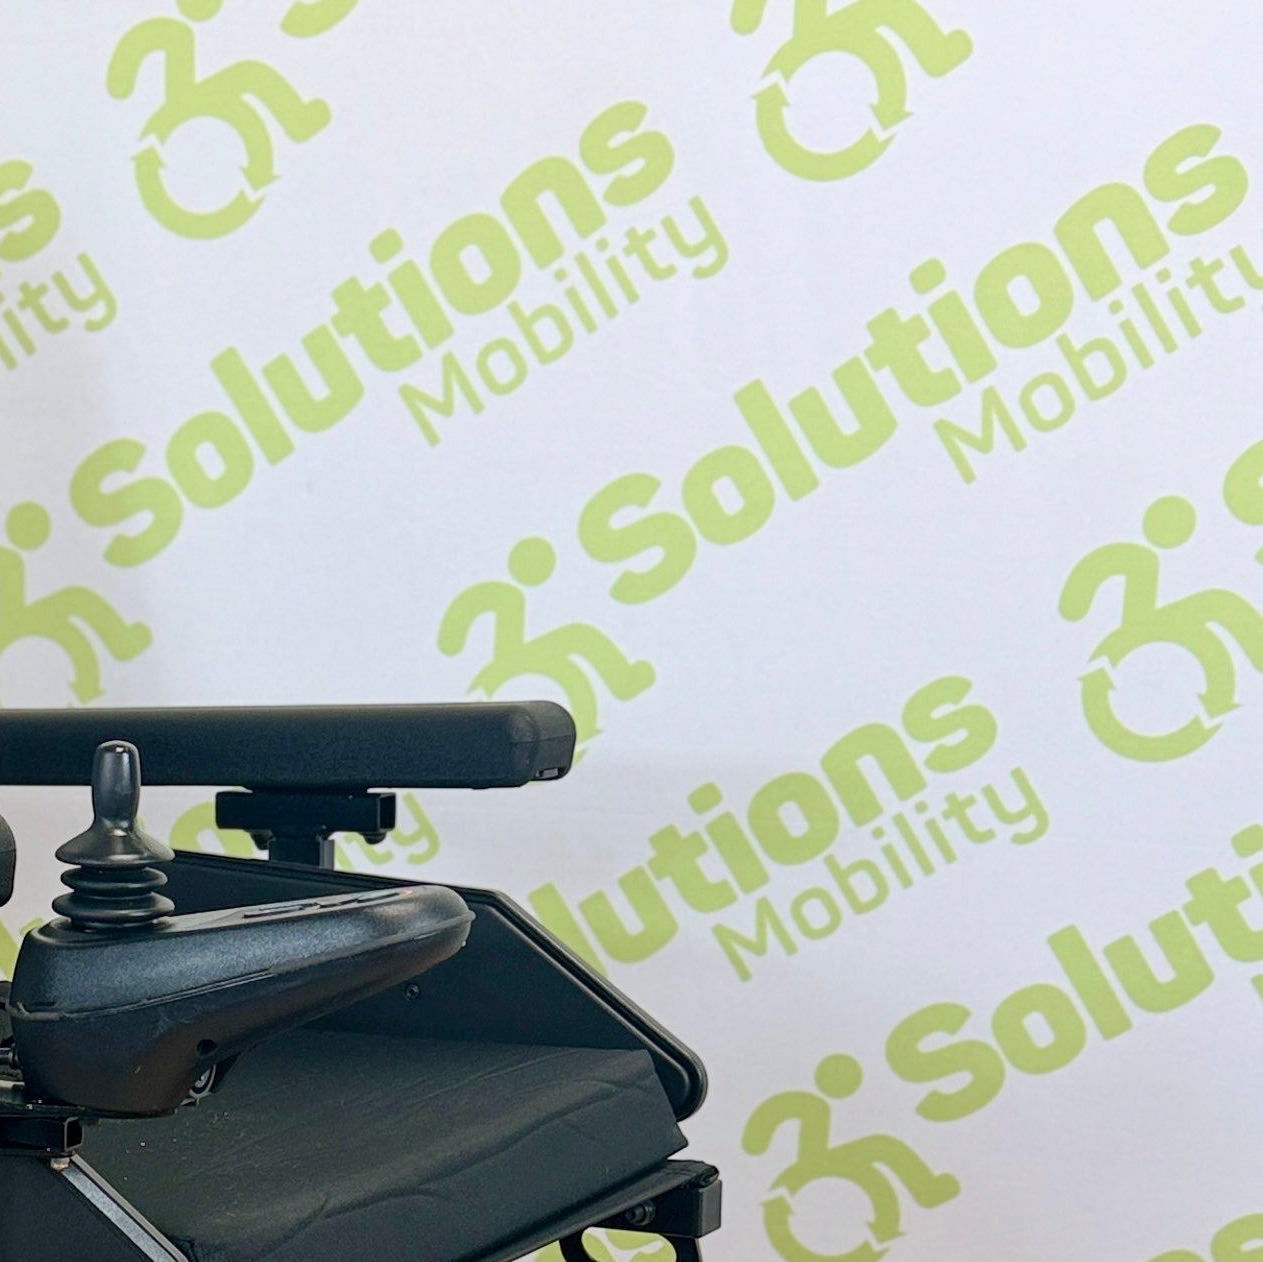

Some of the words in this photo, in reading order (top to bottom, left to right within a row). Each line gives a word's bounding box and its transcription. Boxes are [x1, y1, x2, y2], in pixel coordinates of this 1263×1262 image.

[70, 101, 674, 567] Solutions
[399, 198, 727, 445] Mobility
[579, 124, 1248, 604] Solutions
[712, 770, 1049, 983] Mobility
